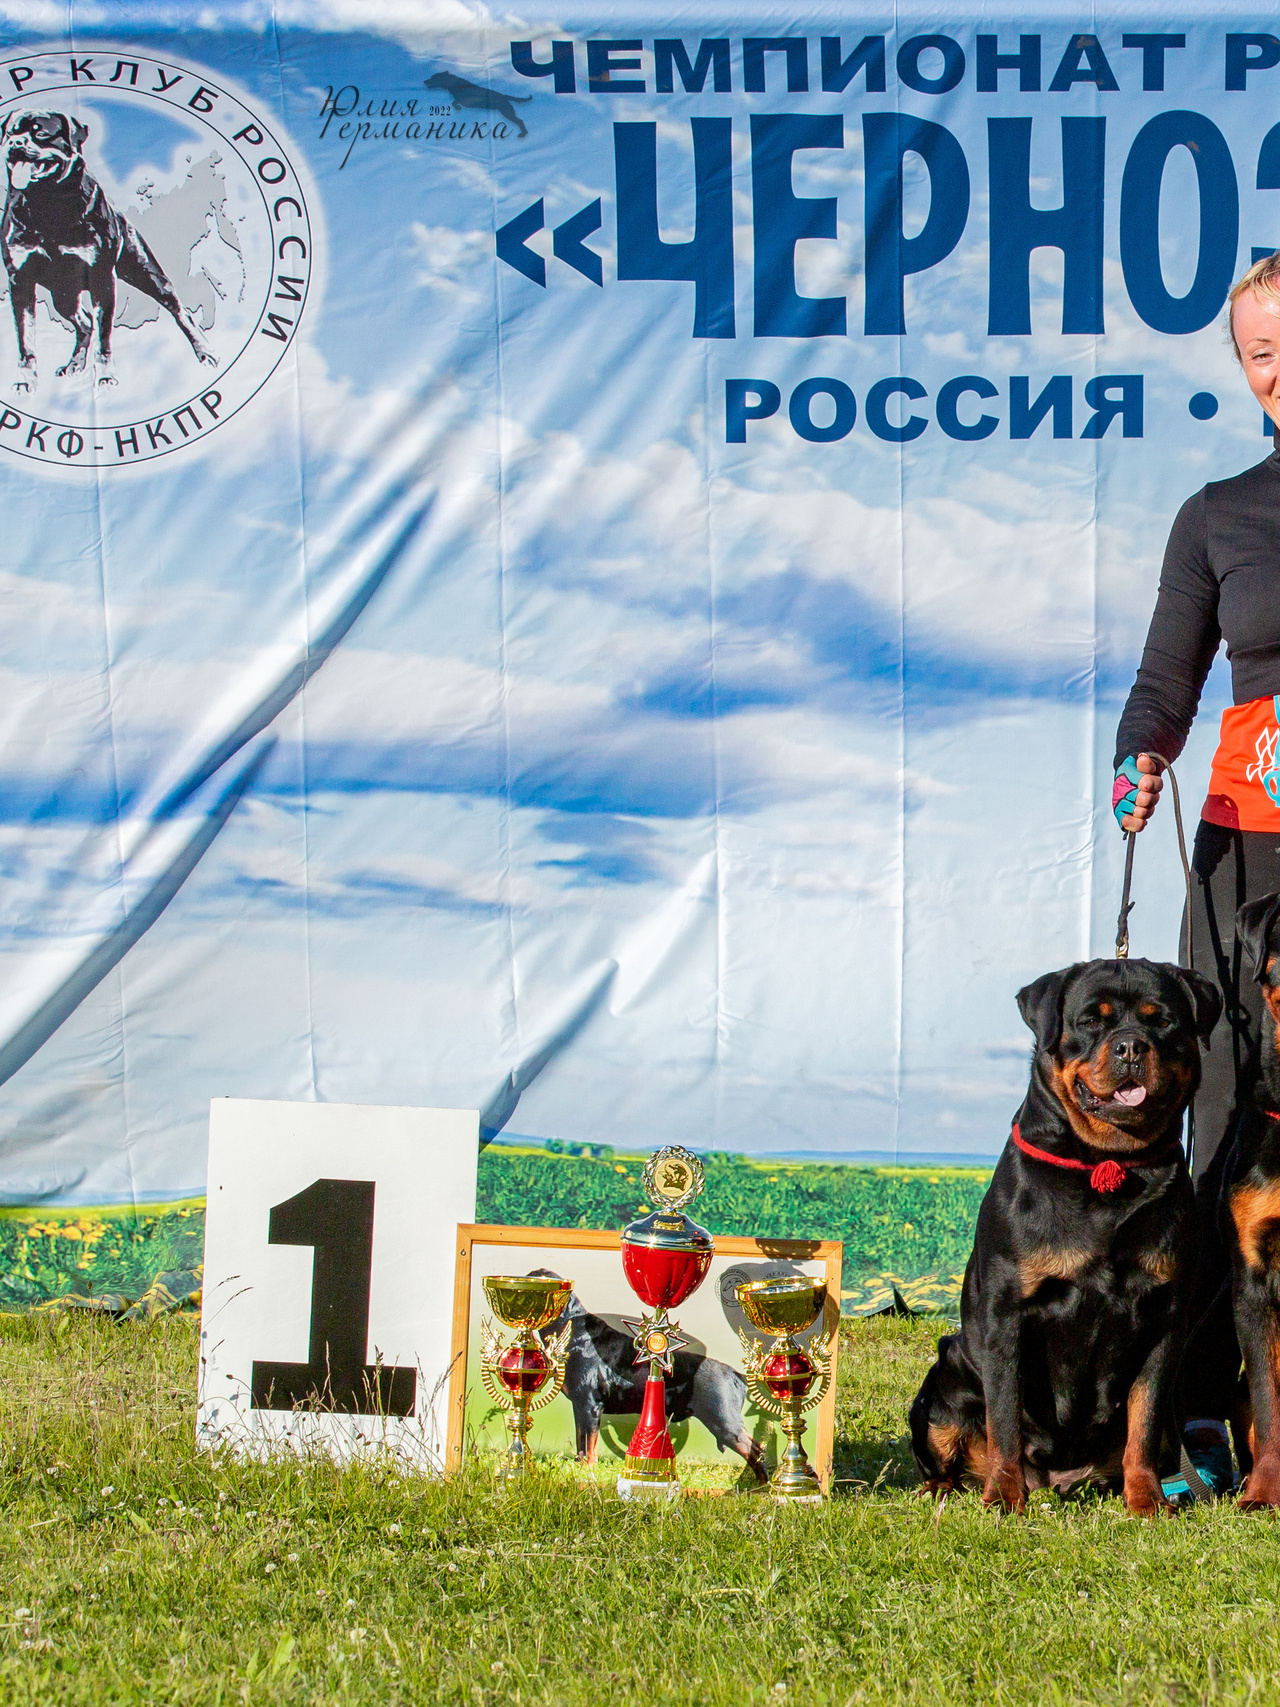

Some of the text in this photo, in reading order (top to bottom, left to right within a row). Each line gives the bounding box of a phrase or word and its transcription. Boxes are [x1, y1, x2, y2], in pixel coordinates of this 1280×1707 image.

[510, 33, 1187, 94] ЧЕМПИОНАТ
[70, 58, 220, 113] КЛУБ
[232, 123, 307, 343] РОССИИ
[0, 389, 223, 459] РКФ-НКПР
[725, 374, 1144, 444] РОССИЯ
[250, 1178, 418, 1418] 1
